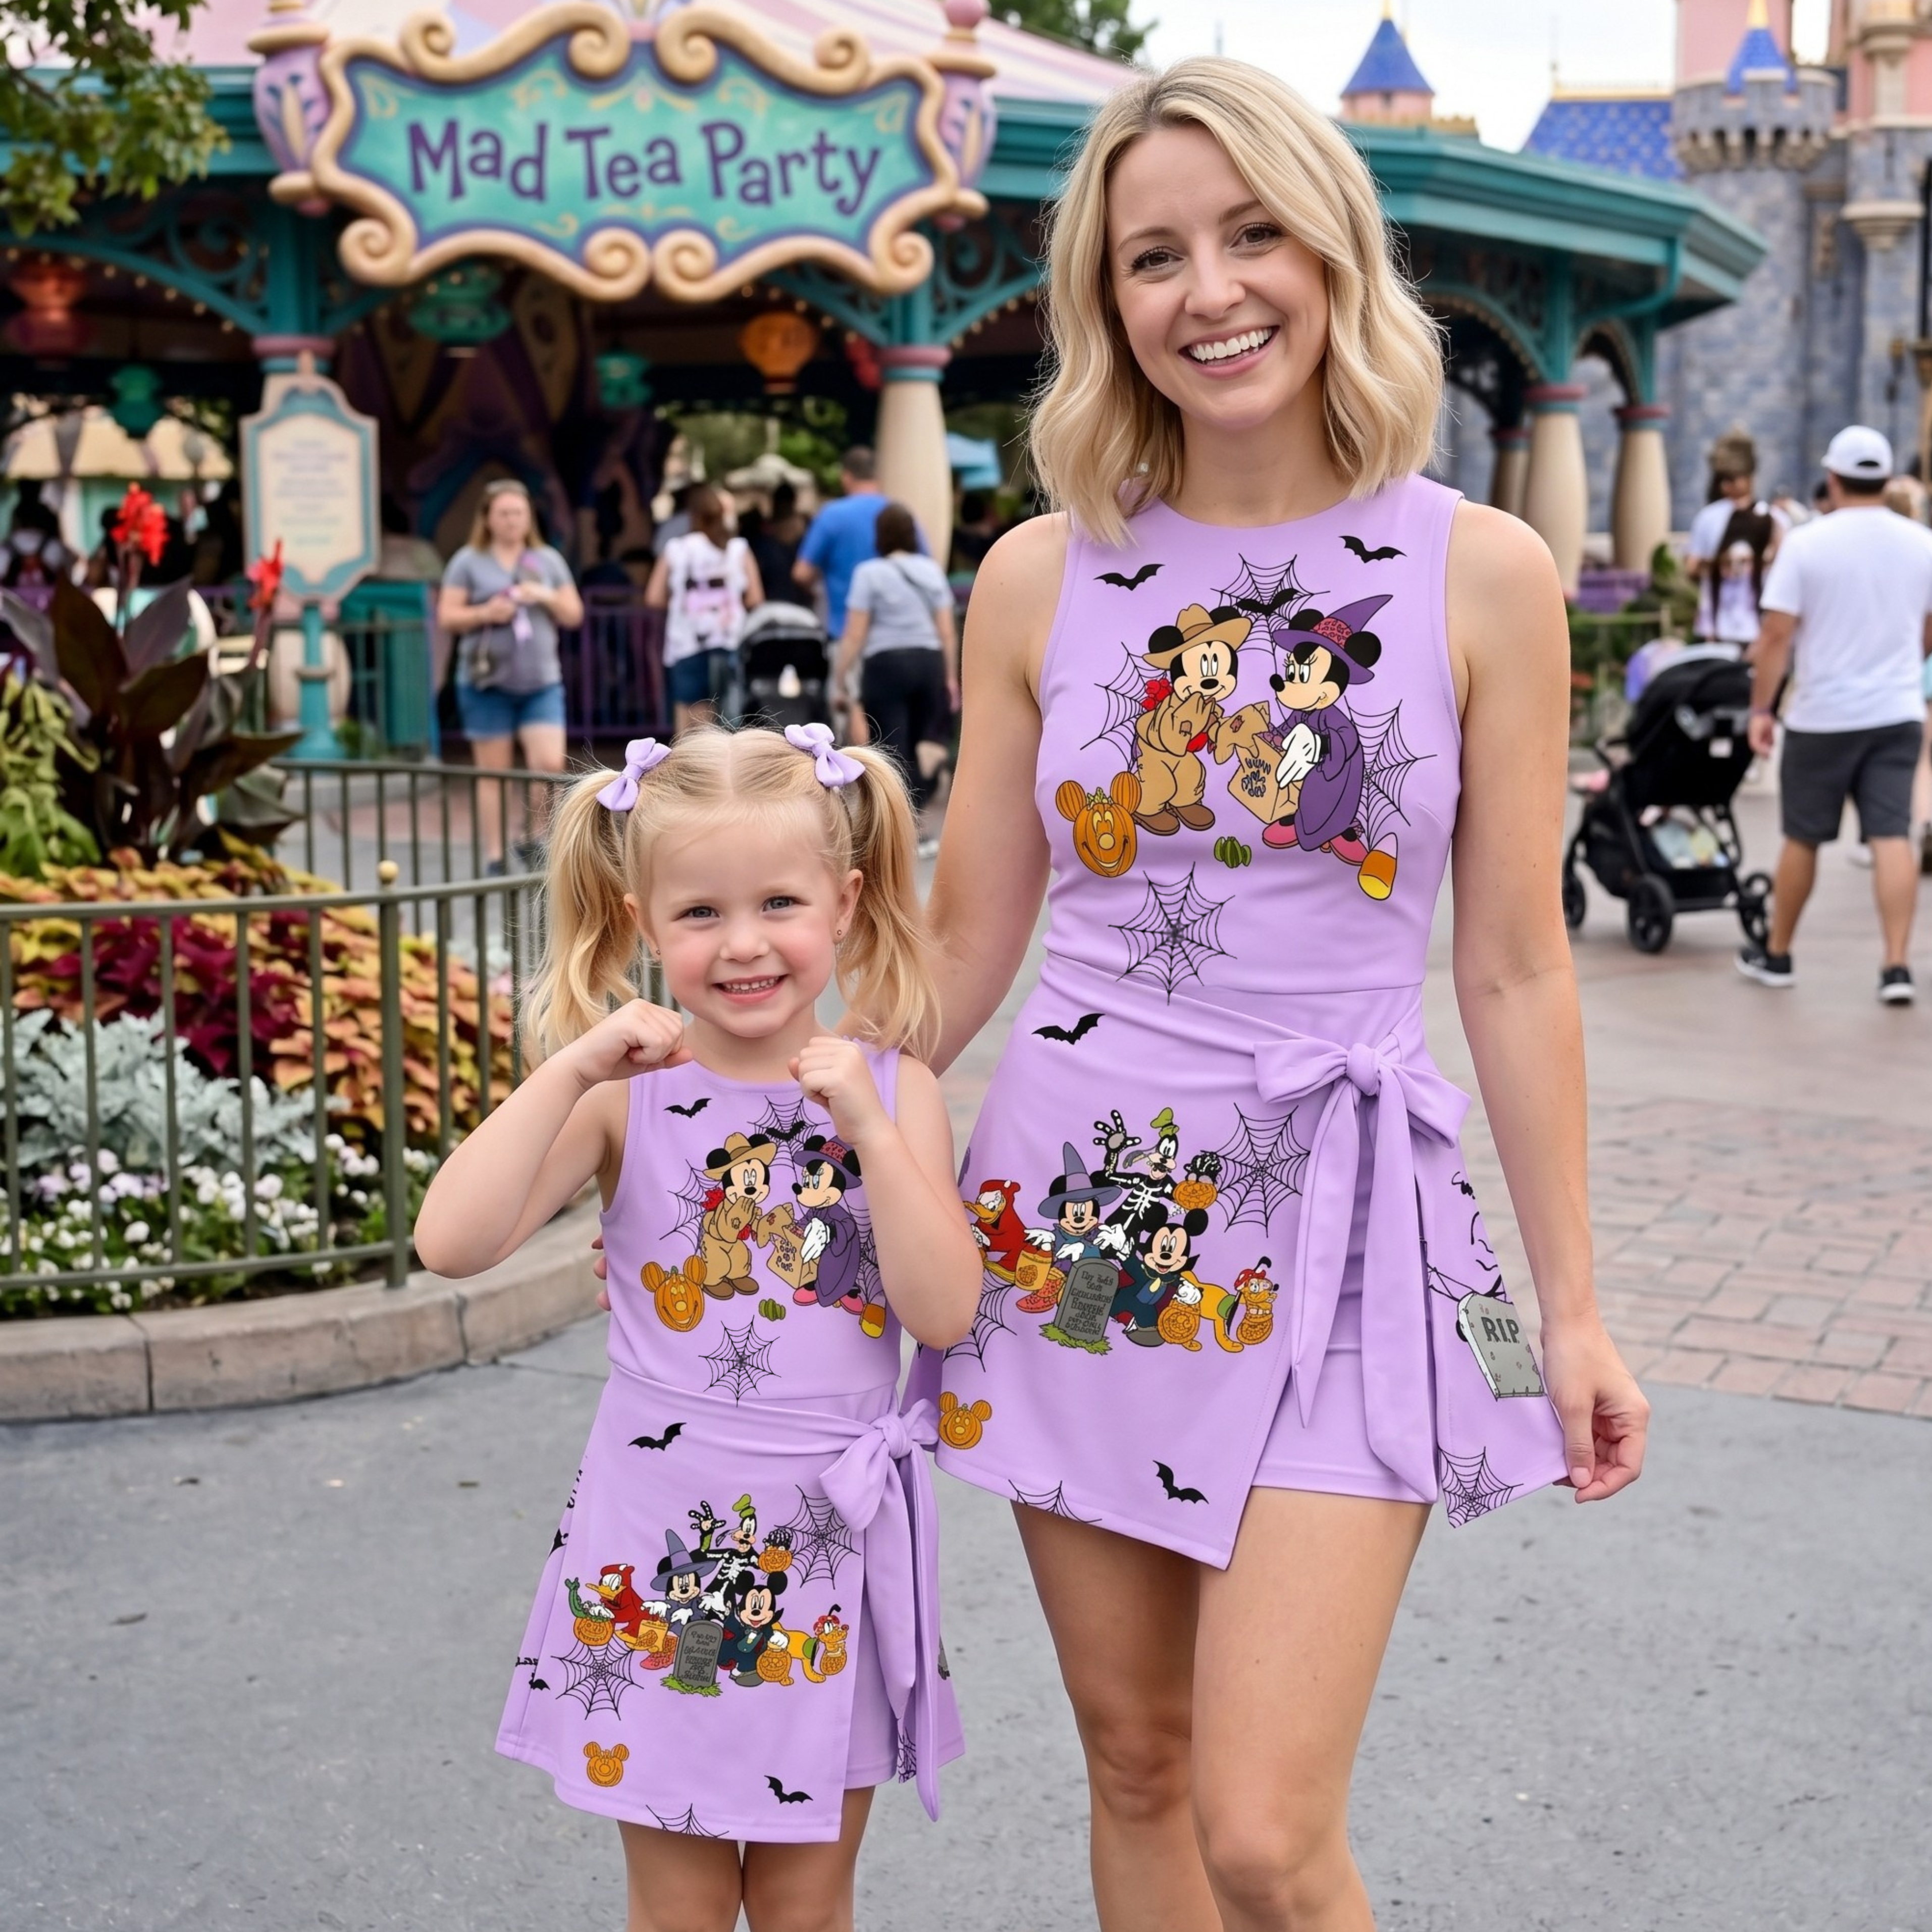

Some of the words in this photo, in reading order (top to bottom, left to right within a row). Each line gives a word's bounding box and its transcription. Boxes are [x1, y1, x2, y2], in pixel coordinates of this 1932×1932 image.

[407, 119, 548, 202] Mad
[564, 126, 683, 200] Tea
[701, 120, 881, 217] Party
